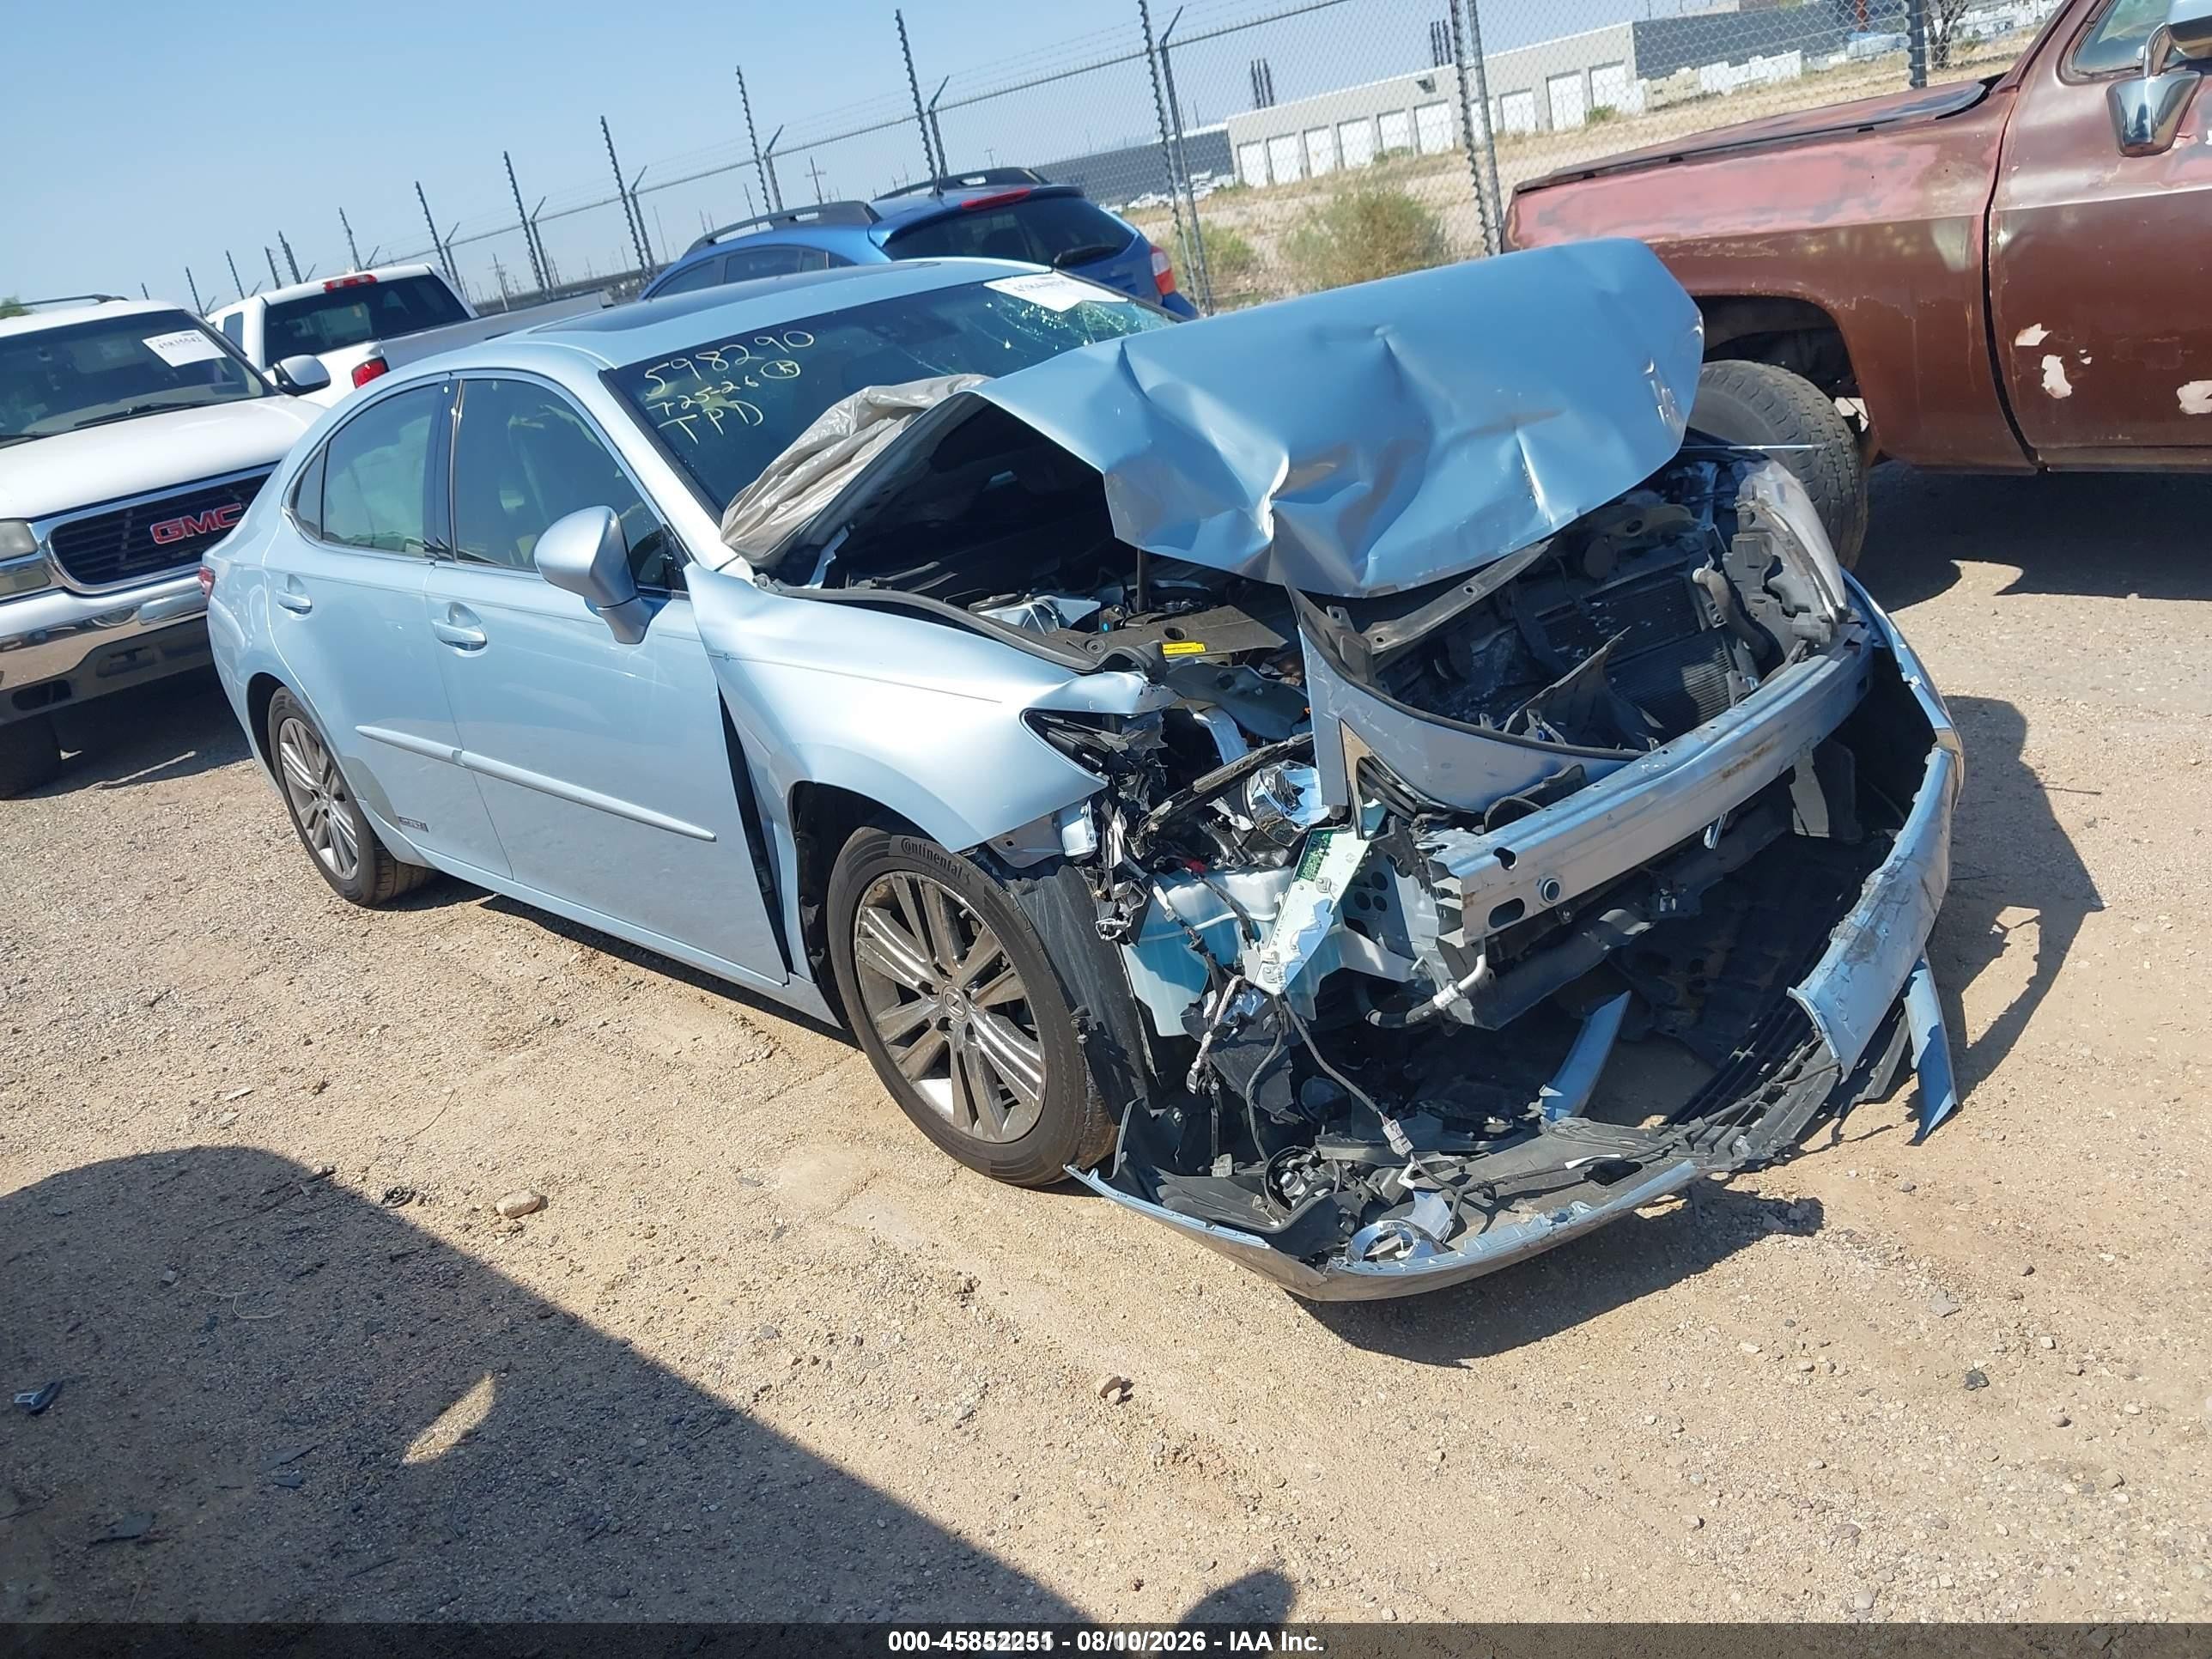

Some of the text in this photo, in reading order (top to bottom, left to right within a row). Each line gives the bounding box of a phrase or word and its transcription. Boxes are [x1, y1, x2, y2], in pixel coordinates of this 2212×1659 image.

[645, 331, 814, 397] 598290
[658, 400, 763, 444] TPD
[150, 502, 242, 544] GMC
[901, 838, 962, 878] Continental
